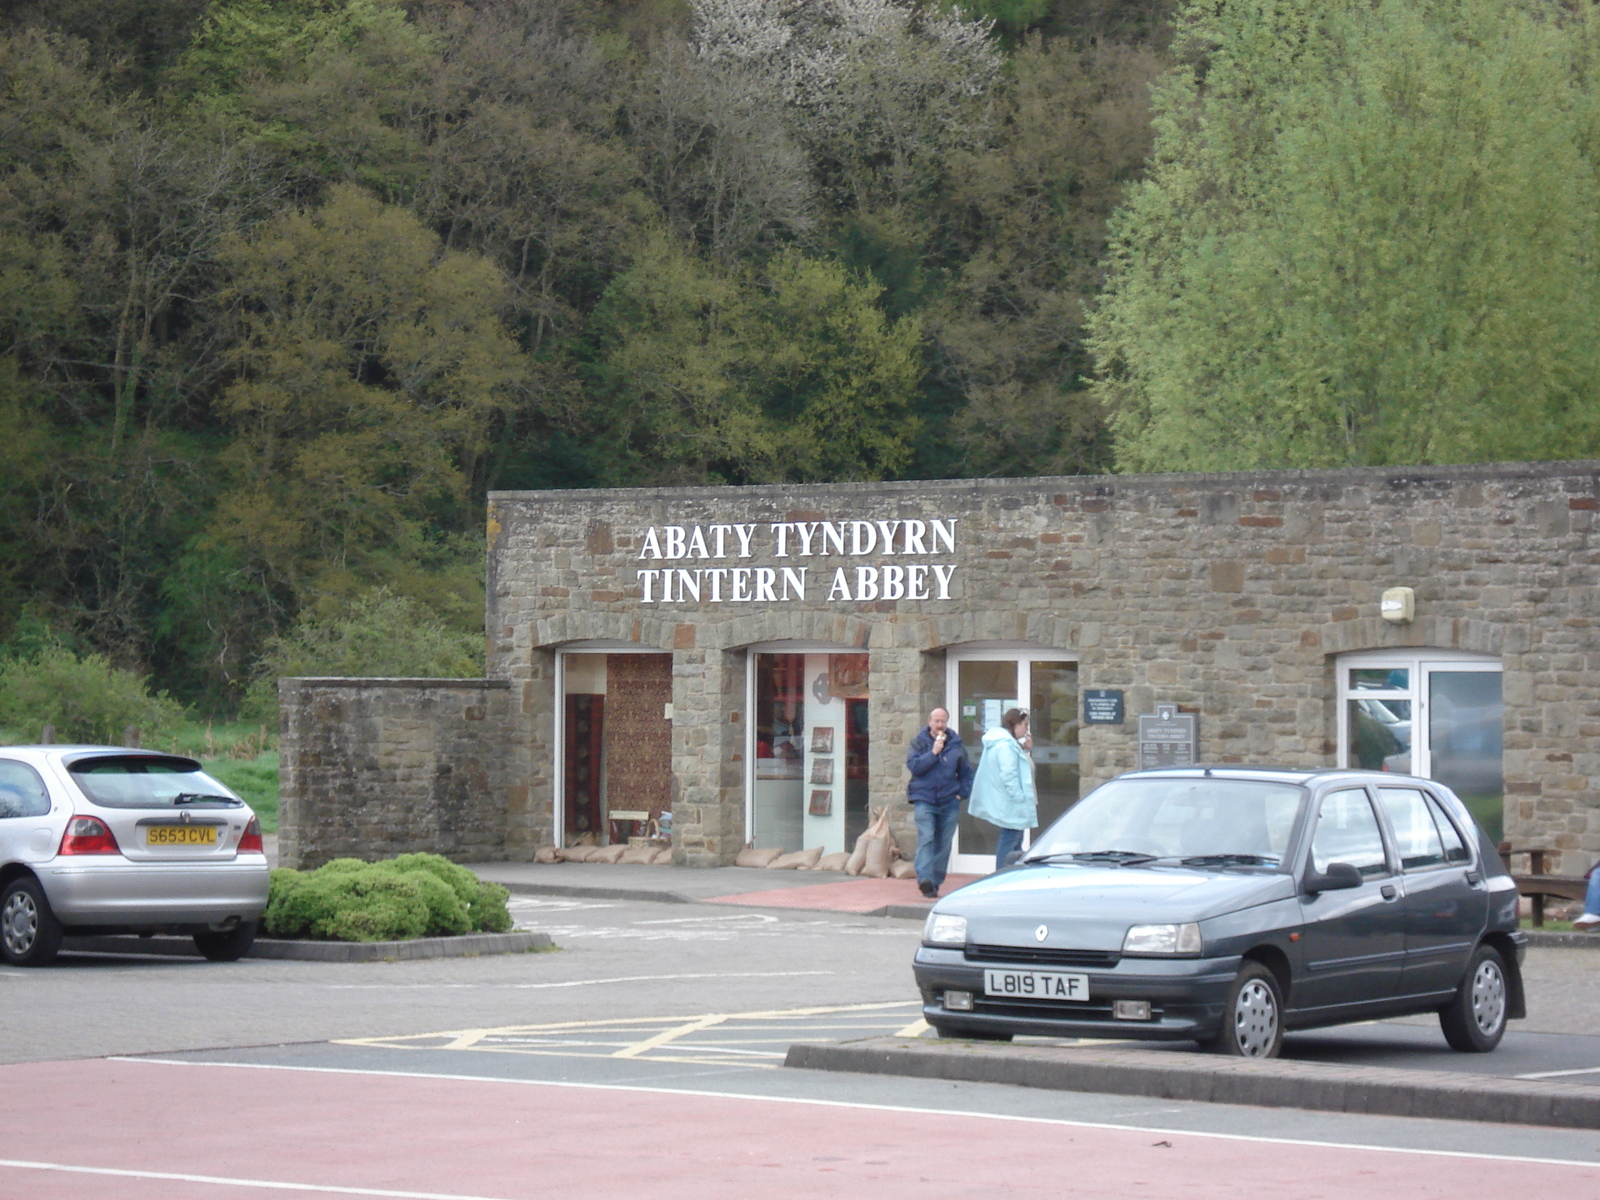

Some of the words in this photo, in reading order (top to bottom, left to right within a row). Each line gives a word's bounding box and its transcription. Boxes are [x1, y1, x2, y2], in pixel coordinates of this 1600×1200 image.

[638, 523, 757, 560] ABATY
[771, 518, 958, 558] TYNDYRN
[637, 567, 808, 603] TINTERN
[827, 564, 958, 601] ABBEY
[149, 829, 186, 843] S653
[188, 829, 215, 843] CVL
[990, 973, 1035, 994] L819
[1041, 976, 1080, 996] TAF
